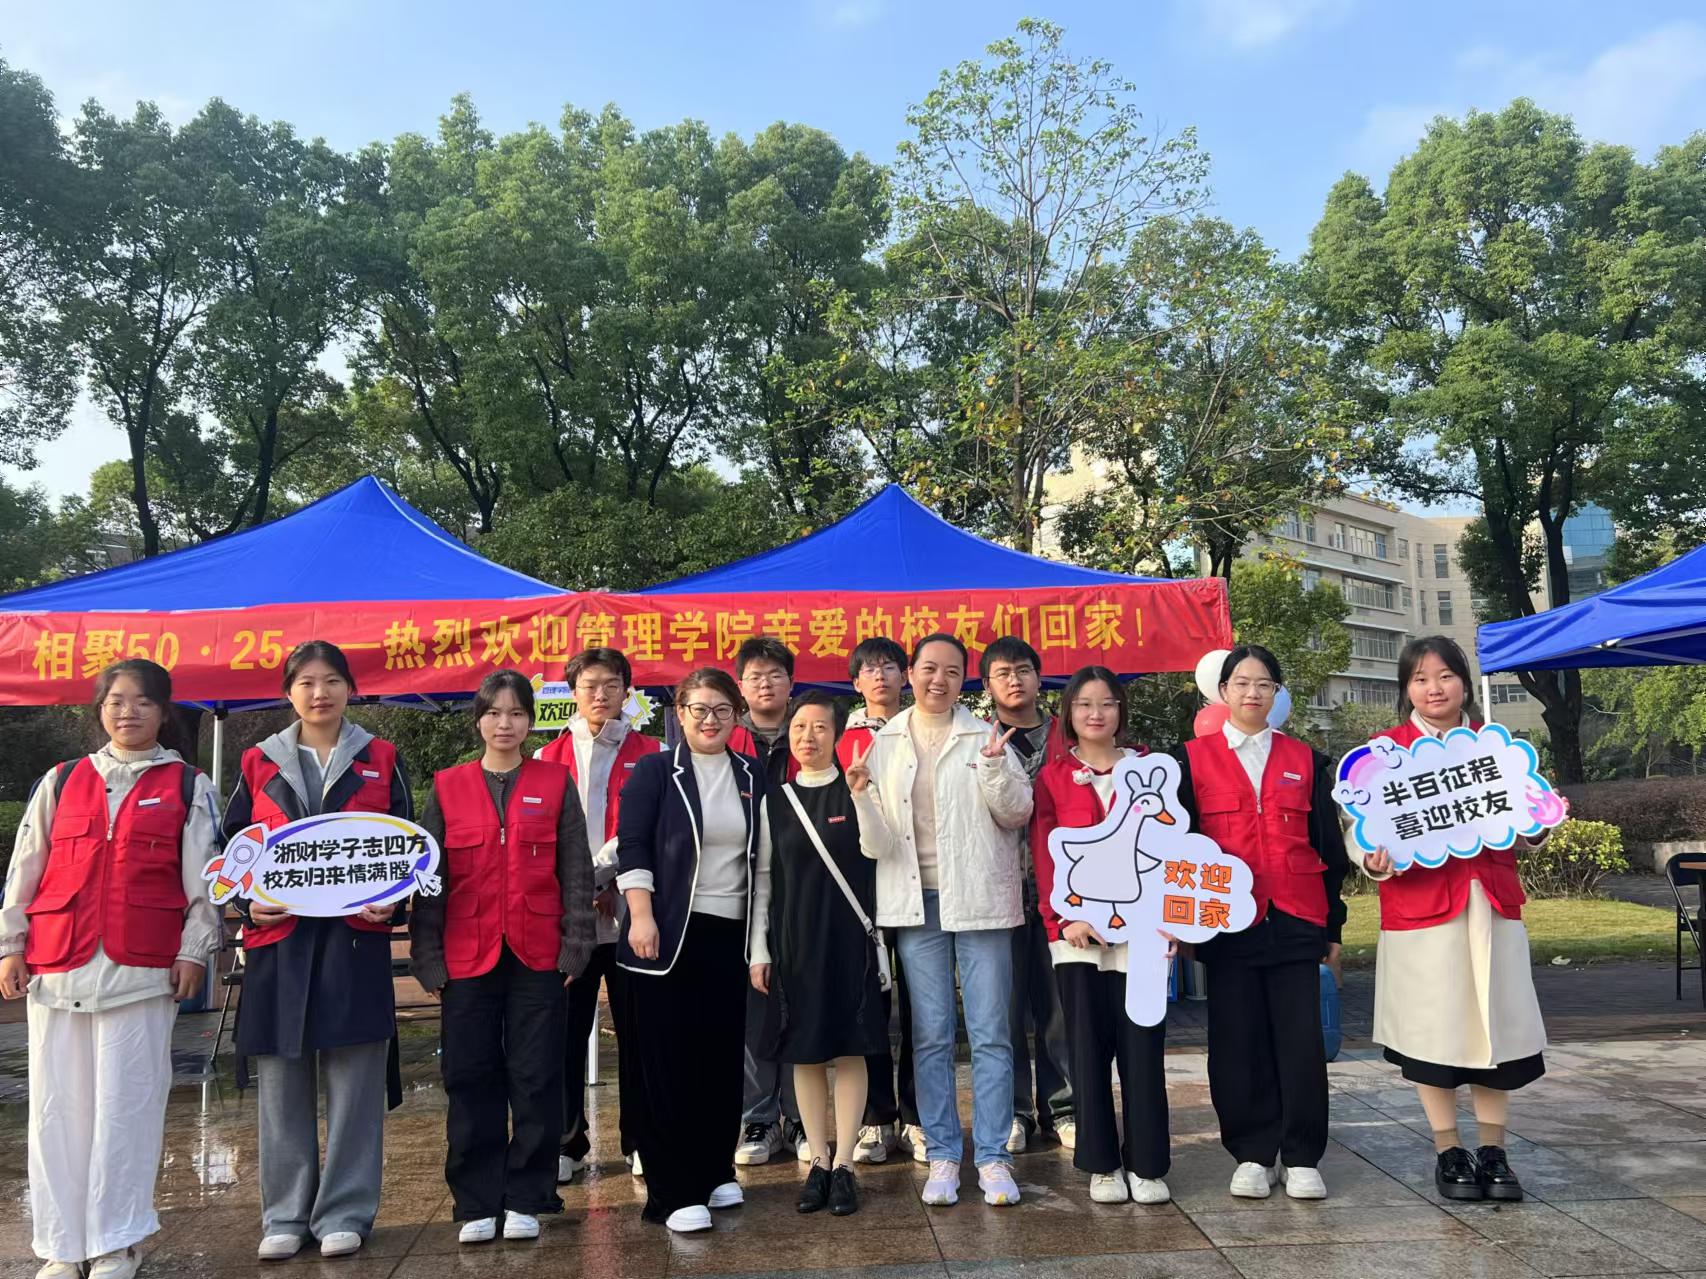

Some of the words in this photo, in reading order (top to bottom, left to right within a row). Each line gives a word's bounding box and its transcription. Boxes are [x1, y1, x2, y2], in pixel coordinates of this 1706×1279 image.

[1383, 755, 1502, 806] 半百征程
[1391, 790, 1513, 840] 喜迎校友
[274, 833, 427, 864] 浙财学子志四方
[263, 860, 410, 890] 校友归来情满膛
[1164, 860, 1232, 894] 欢迎
[1162, 894, 1231, 929] 回家
